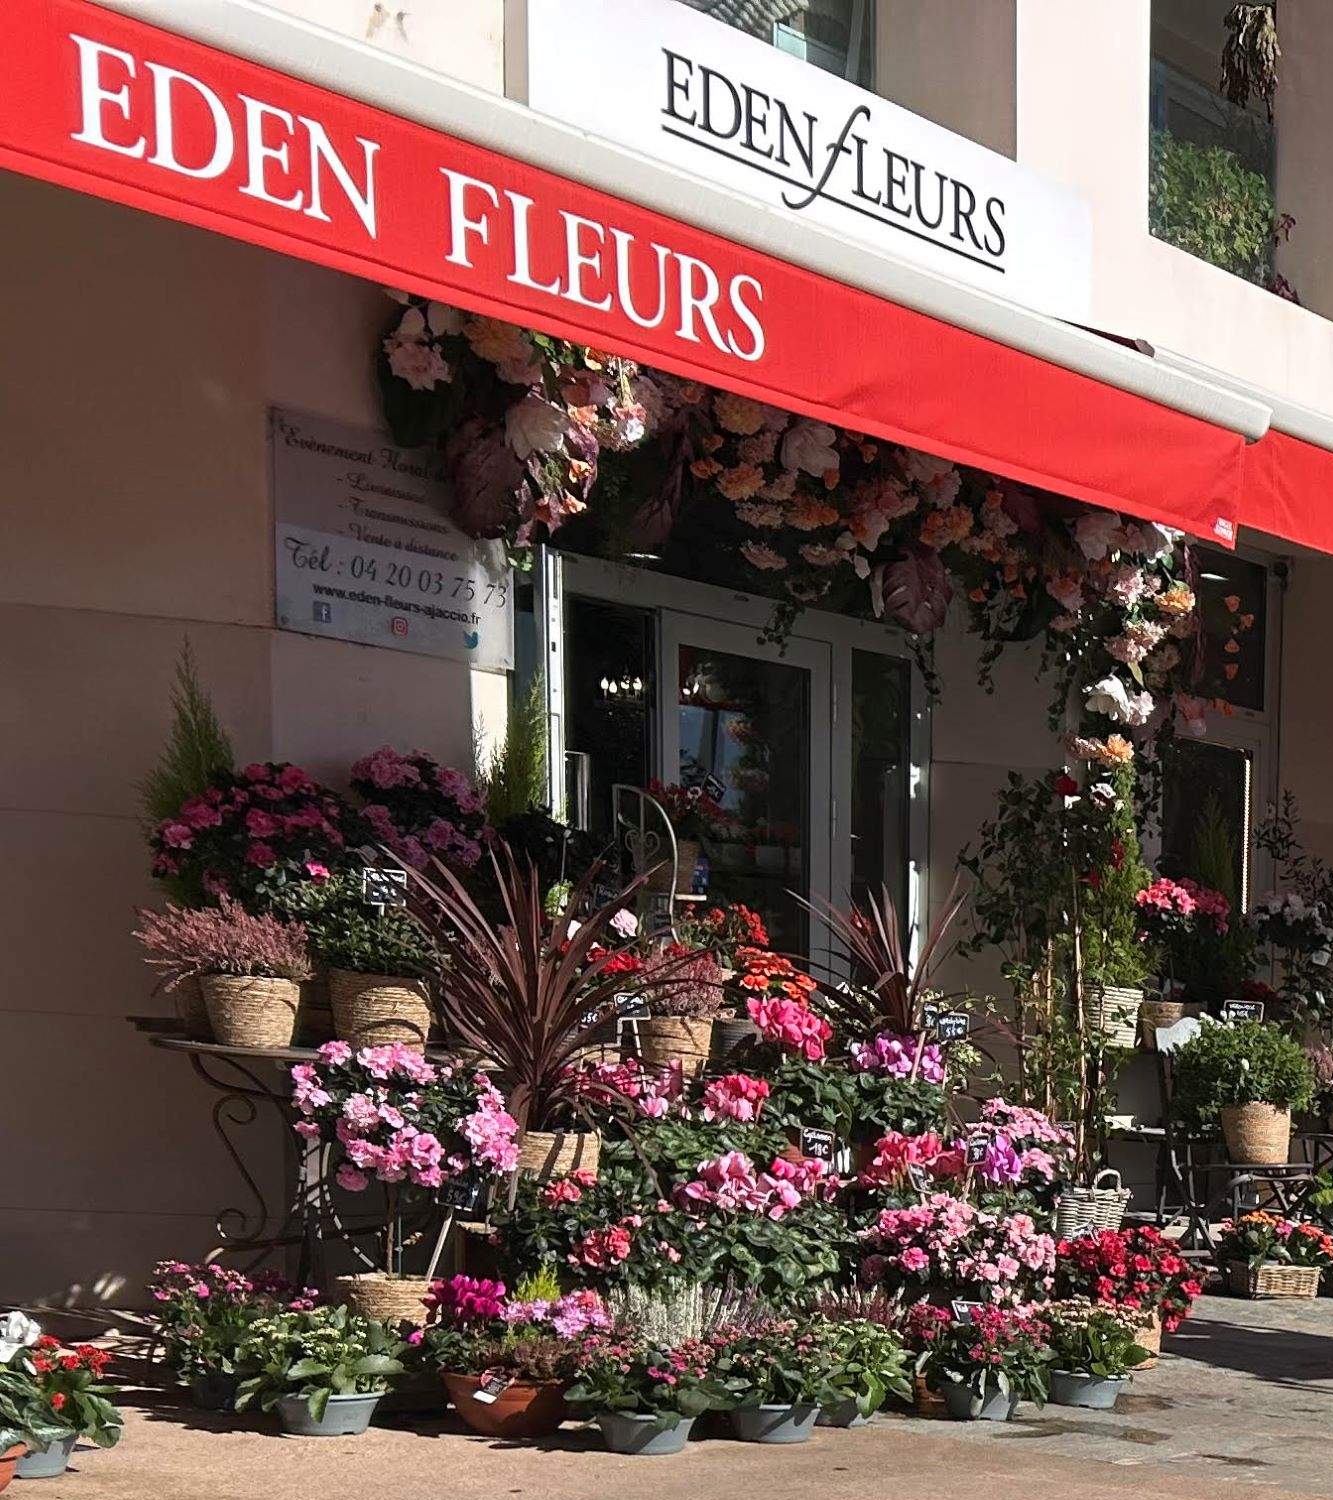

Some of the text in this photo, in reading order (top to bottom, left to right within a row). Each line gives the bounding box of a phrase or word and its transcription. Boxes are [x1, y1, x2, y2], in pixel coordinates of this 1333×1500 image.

[70, 34, 767, 363] EDEN FLEURS
[349, 522, 393, 548] Vente
[405, 537, 460, 562] distance
[285, 536, 333, 573] Tél
[351, 555, 378, 582] 04
[385, 562, 412, 588] 20
[418, 568, 445, 596] 03
[450, 576, 476, 602] 75
[483, 583, 508, 609] 73
[312, 582, 482, 626] www.eden-fleurs-ajaccio.fr
